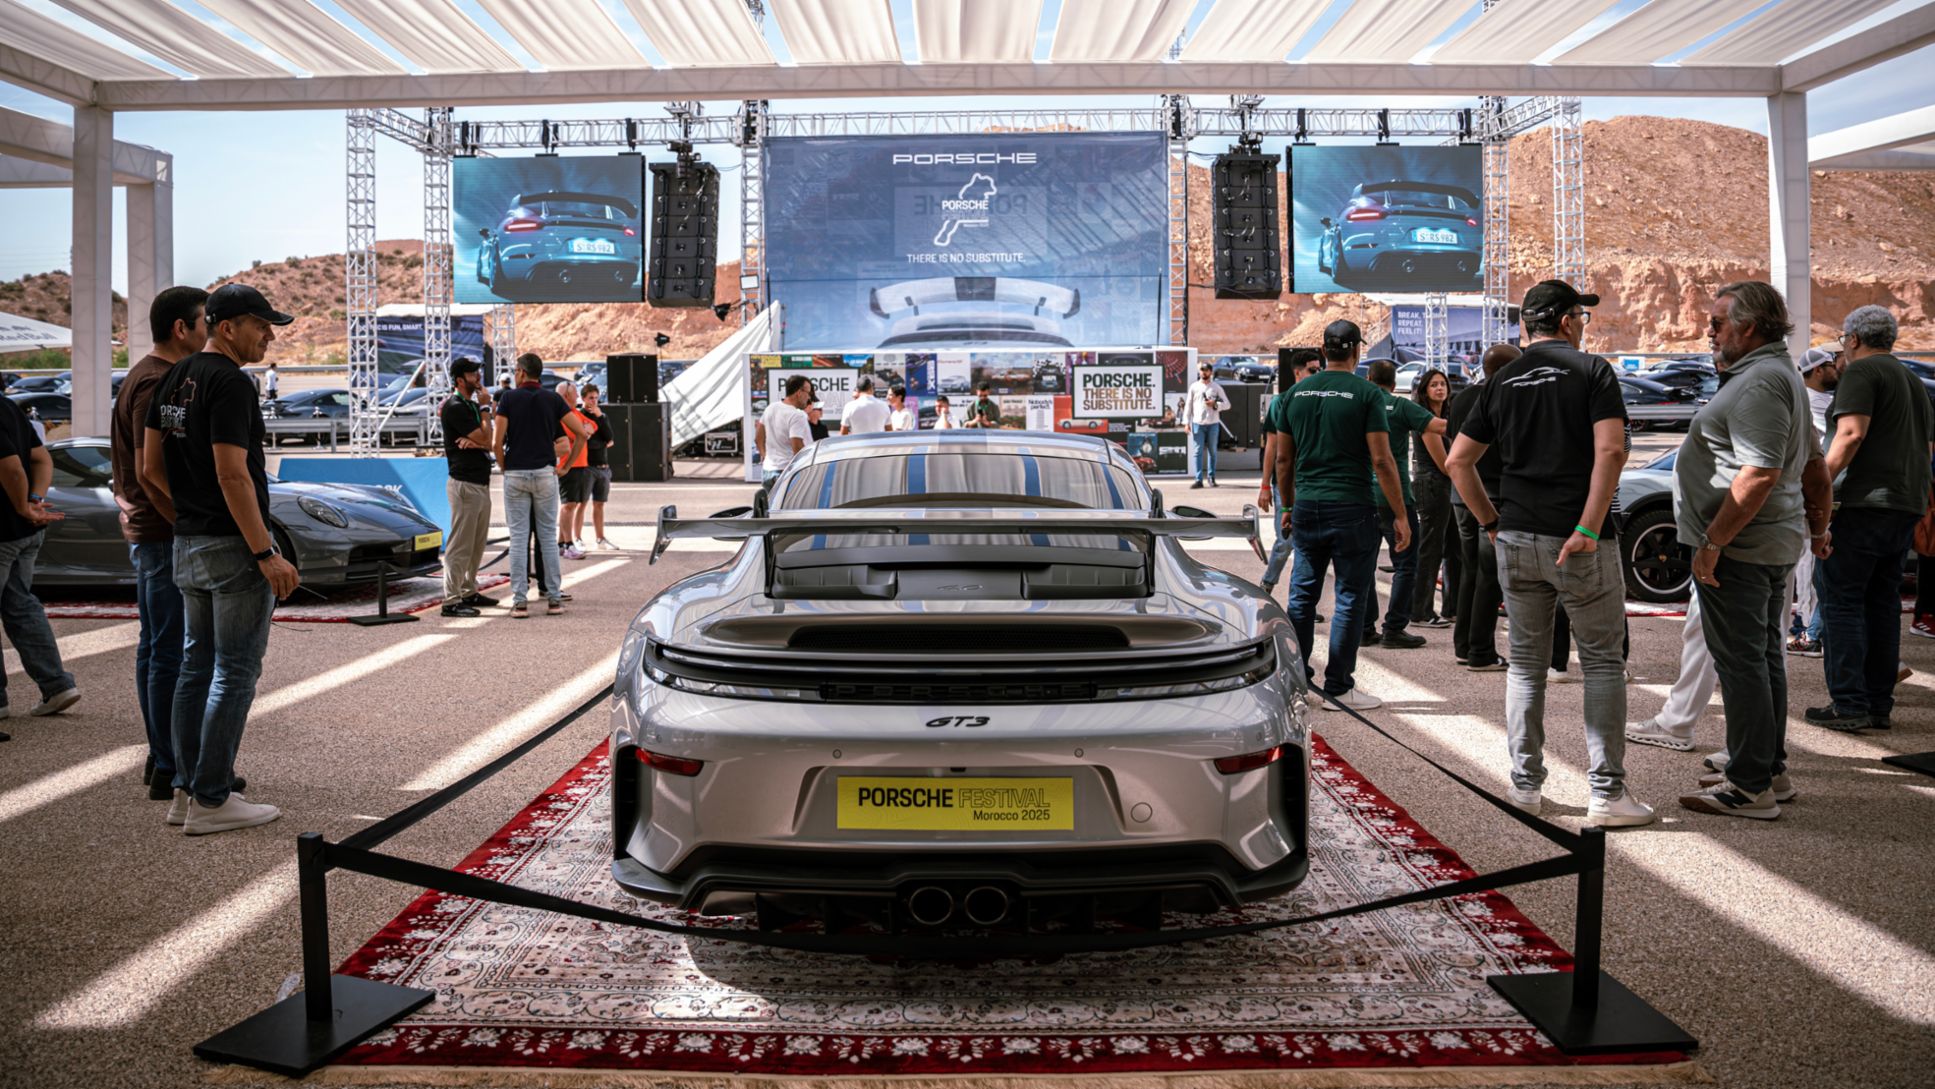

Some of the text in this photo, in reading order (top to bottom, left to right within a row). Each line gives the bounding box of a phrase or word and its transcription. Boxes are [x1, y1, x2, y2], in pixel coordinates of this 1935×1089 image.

[893, 153, 1037, 165] PORSCHE
[942, 200, 989, 210] PORSCHE
[907, 253, 1026, 263] THERE IS NO SUBSTITUTE.
[778, 377, 849, 392] PSCHE
[1083, 373, 1156, 388] PORSCHE.
[1083, 388, 1152, 400] THERE IS NO
[1294, 390, 1354, 400] PORSCHE
[1083, 400, 1156, 411] SUBSTITUTE.
[925, 715, 991, 728] GT3
[858, 787, 1050, 808] PORSCHE FESTIVAL
[973, 809, 1050, 821] Morocco 2025
